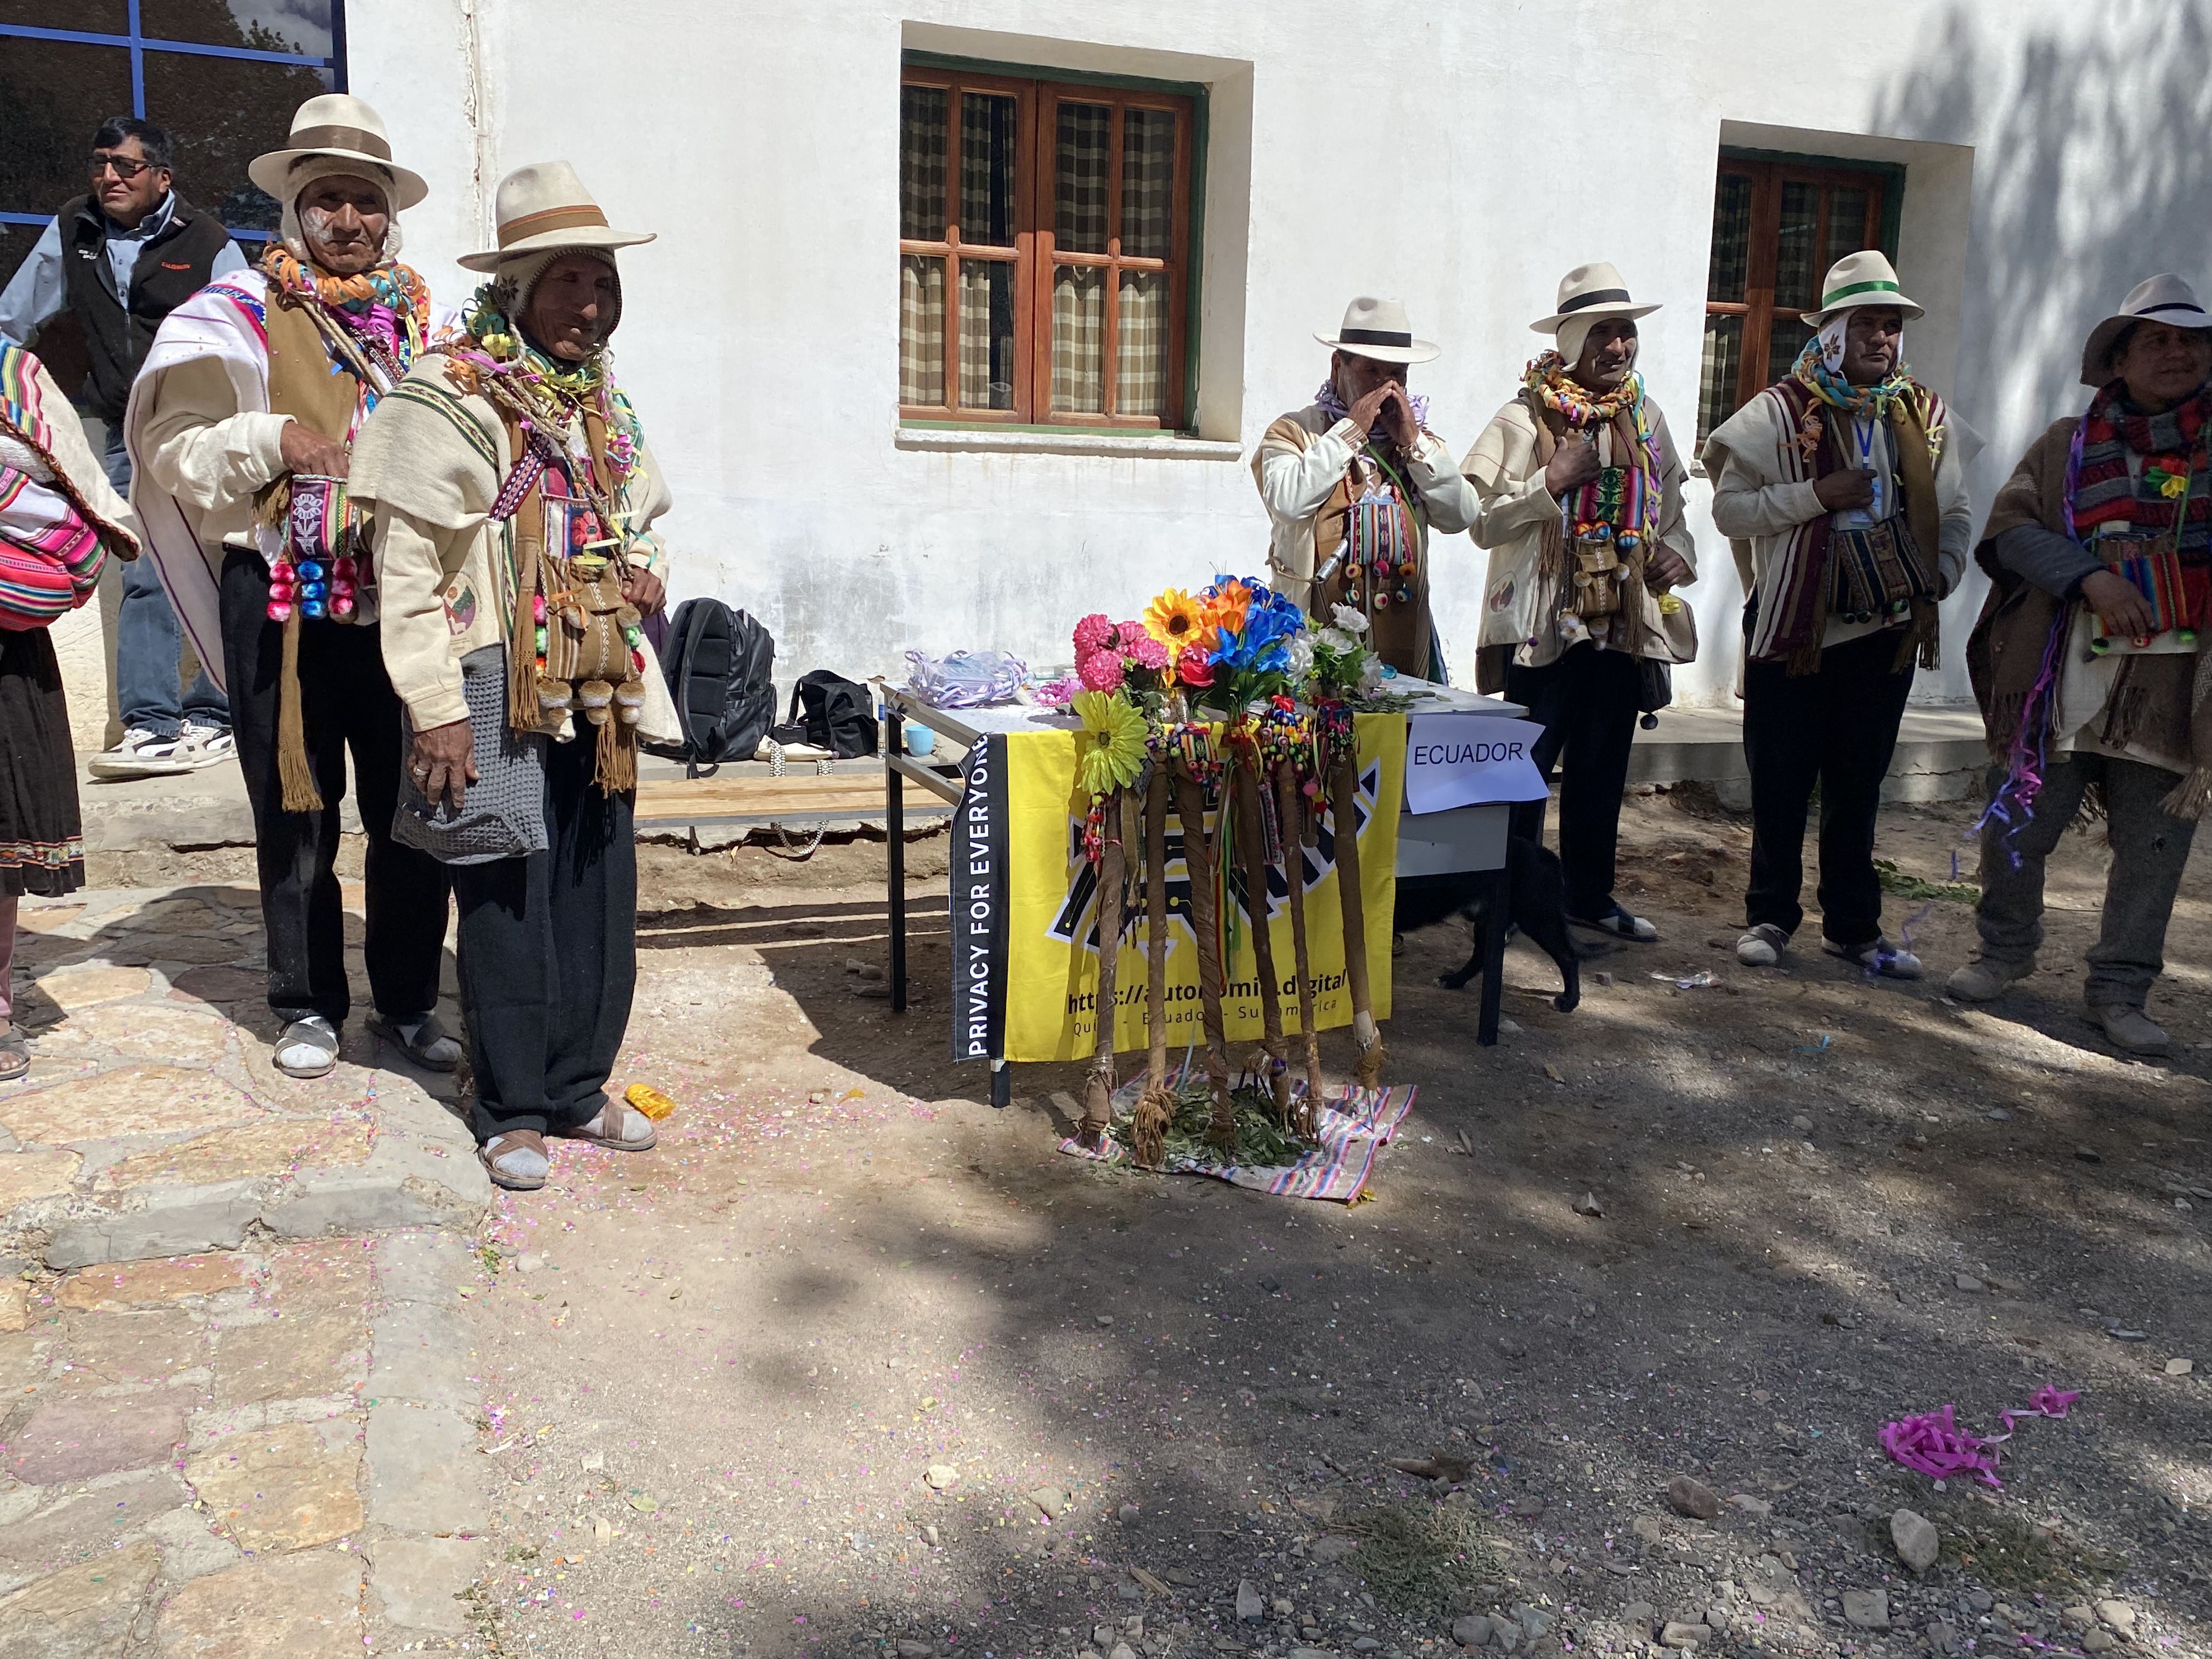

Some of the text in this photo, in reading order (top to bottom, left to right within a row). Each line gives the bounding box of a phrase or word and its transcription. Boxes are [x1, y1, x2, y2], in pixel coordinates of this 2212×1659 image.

[1414, 742, 1523, 765] ECUADOR
[968, 735, 990, 1056] PRIVACY FOR EVERYONE
